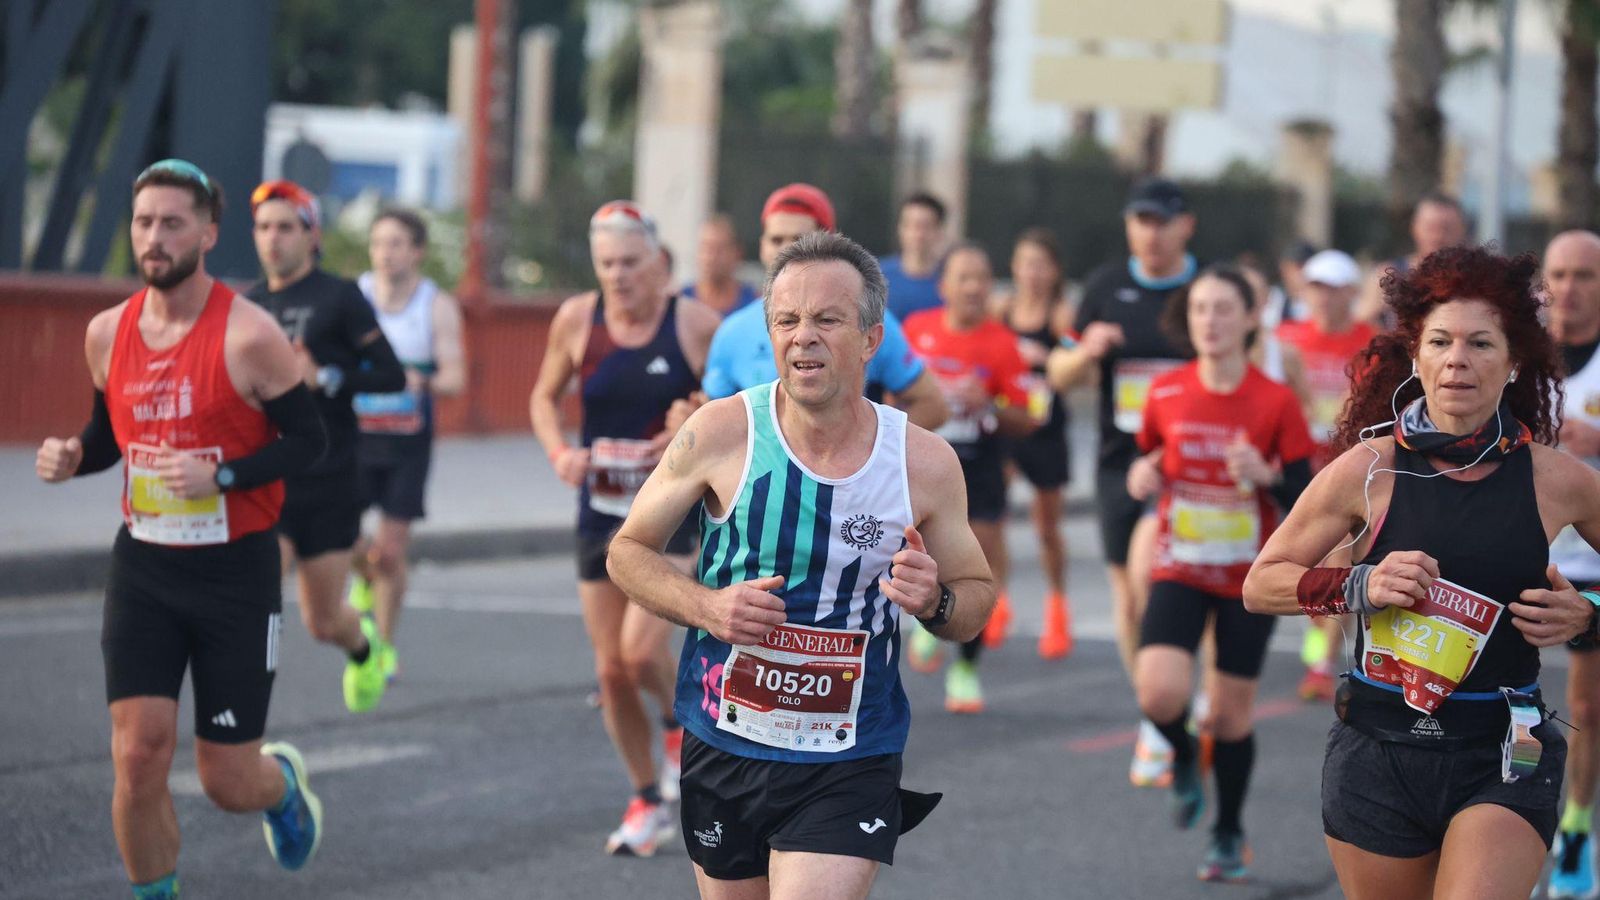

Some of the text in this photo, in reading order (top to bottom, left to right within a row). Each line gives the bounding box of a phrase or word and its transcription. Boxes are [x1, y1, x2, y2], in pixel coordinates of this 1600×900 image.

[1428, 585, 1490, 624] NERALI
[766, 630, 855, 654] GENERALI
[755, 664, 833, 697] 10520
[777, 695, 802, 706] TOLO
[811, 722, 833, 731] 21K
